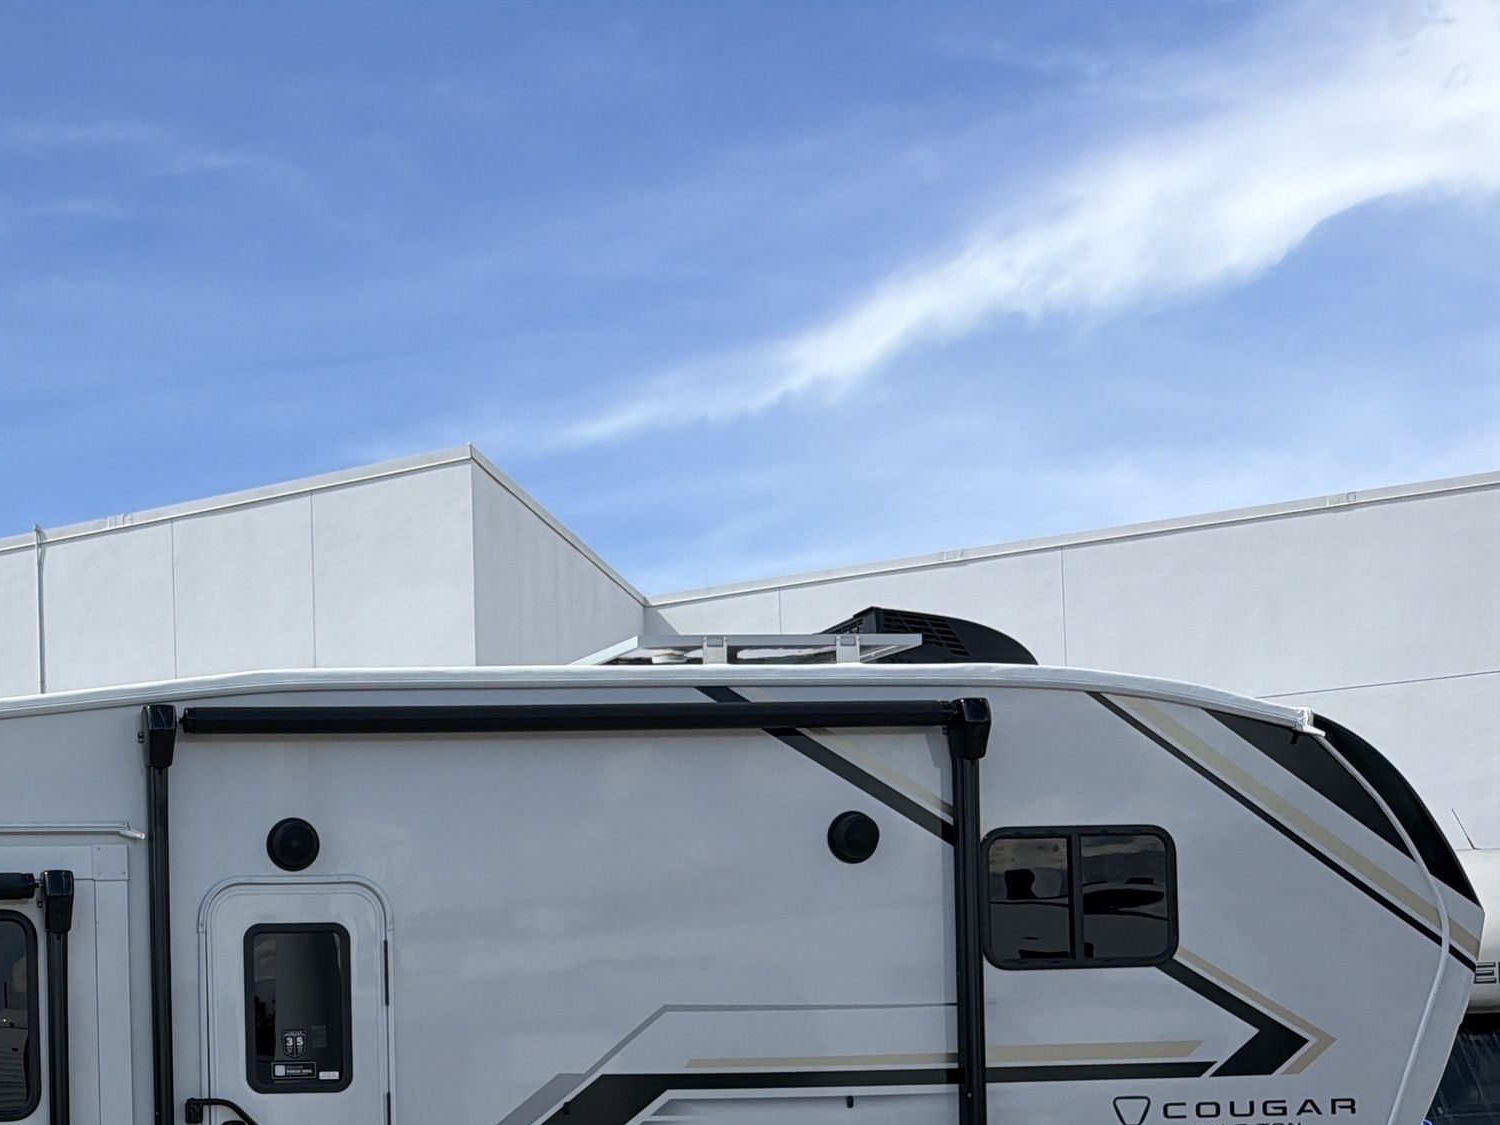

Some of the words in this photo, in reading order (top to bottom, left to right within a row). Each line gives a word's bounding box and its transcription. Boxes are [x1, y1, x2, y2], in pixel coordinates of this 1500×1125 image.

[1474, 961, 1500, 984] E
[286, 1037, 293, 1046] 3
[296, 1036, 304, 1046] 5
[1162, 1098, 1357, 1119] COUGAR
